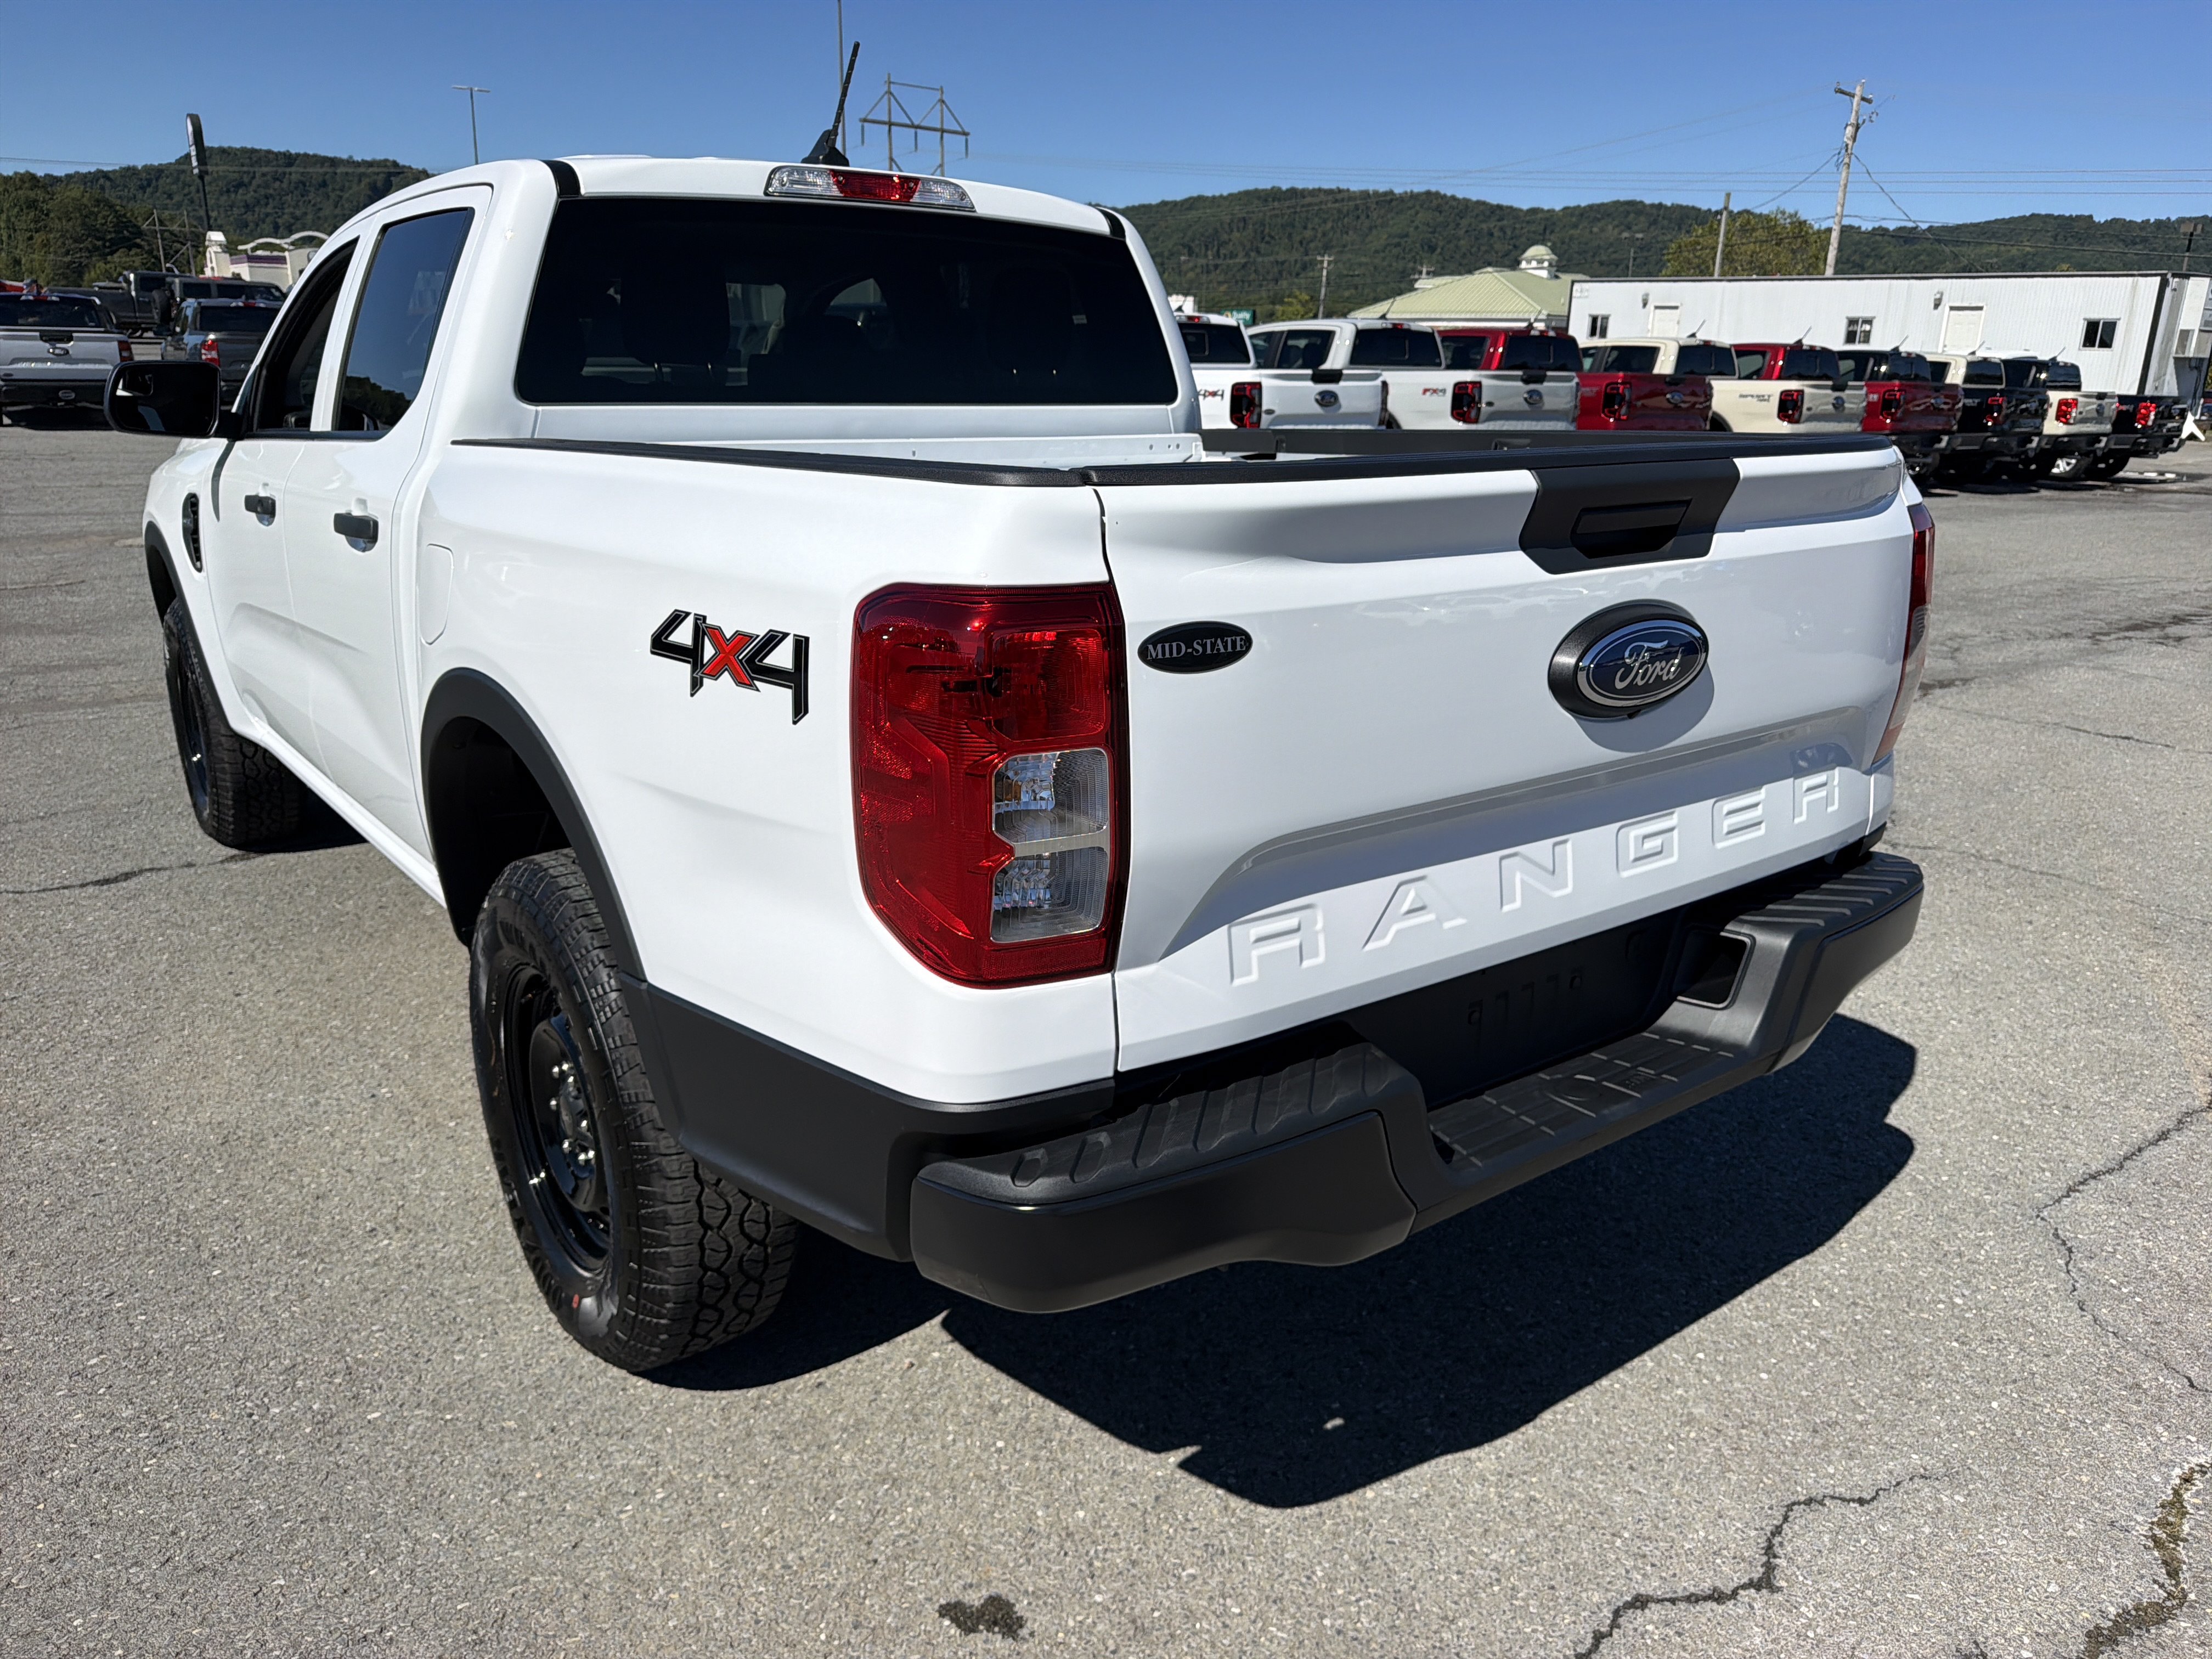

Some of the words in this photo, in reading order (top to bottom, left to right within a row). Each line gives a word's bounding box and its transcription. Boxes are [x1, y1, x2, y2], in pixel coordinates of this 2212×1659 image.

[1146, 635, 1246, 660] MID-STATE
[1615, 639, 1684, 690] Ford
[1227, 766, 1840, 986] RANGER
